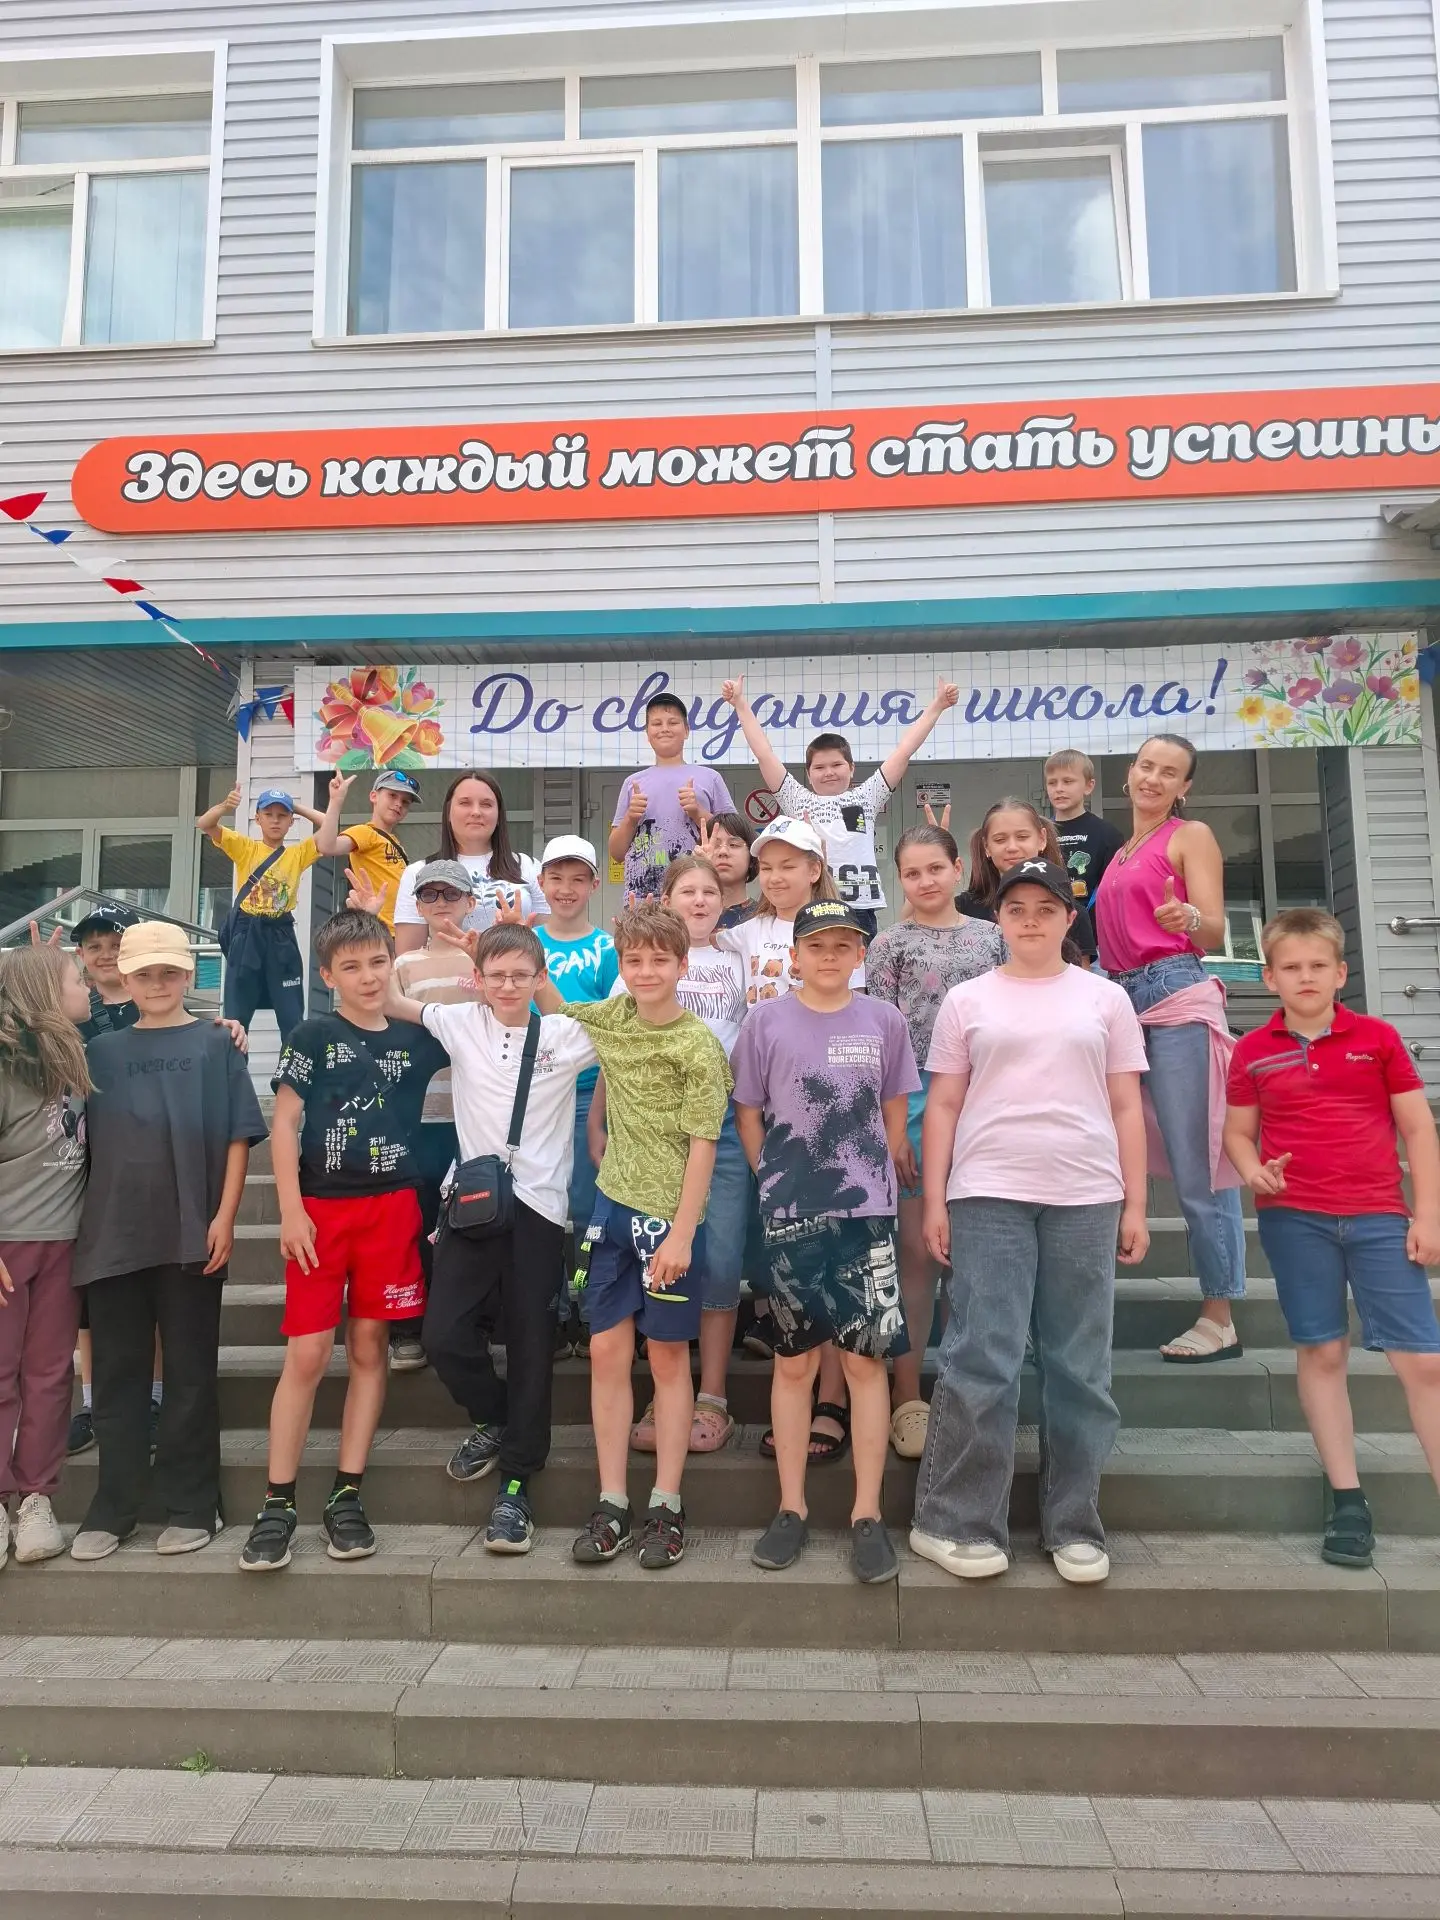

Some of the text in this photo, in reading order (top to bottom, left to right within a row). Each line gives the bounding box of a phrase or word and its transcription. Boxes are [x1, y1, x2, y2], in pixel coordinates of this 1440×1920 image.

[121, 412, 1440, 502] Здесь каждый может стать успешны
[469, 671, 585, 735] До
[964, 656, 1229, 723] школа!
[827, 864, 880, 902] ST
